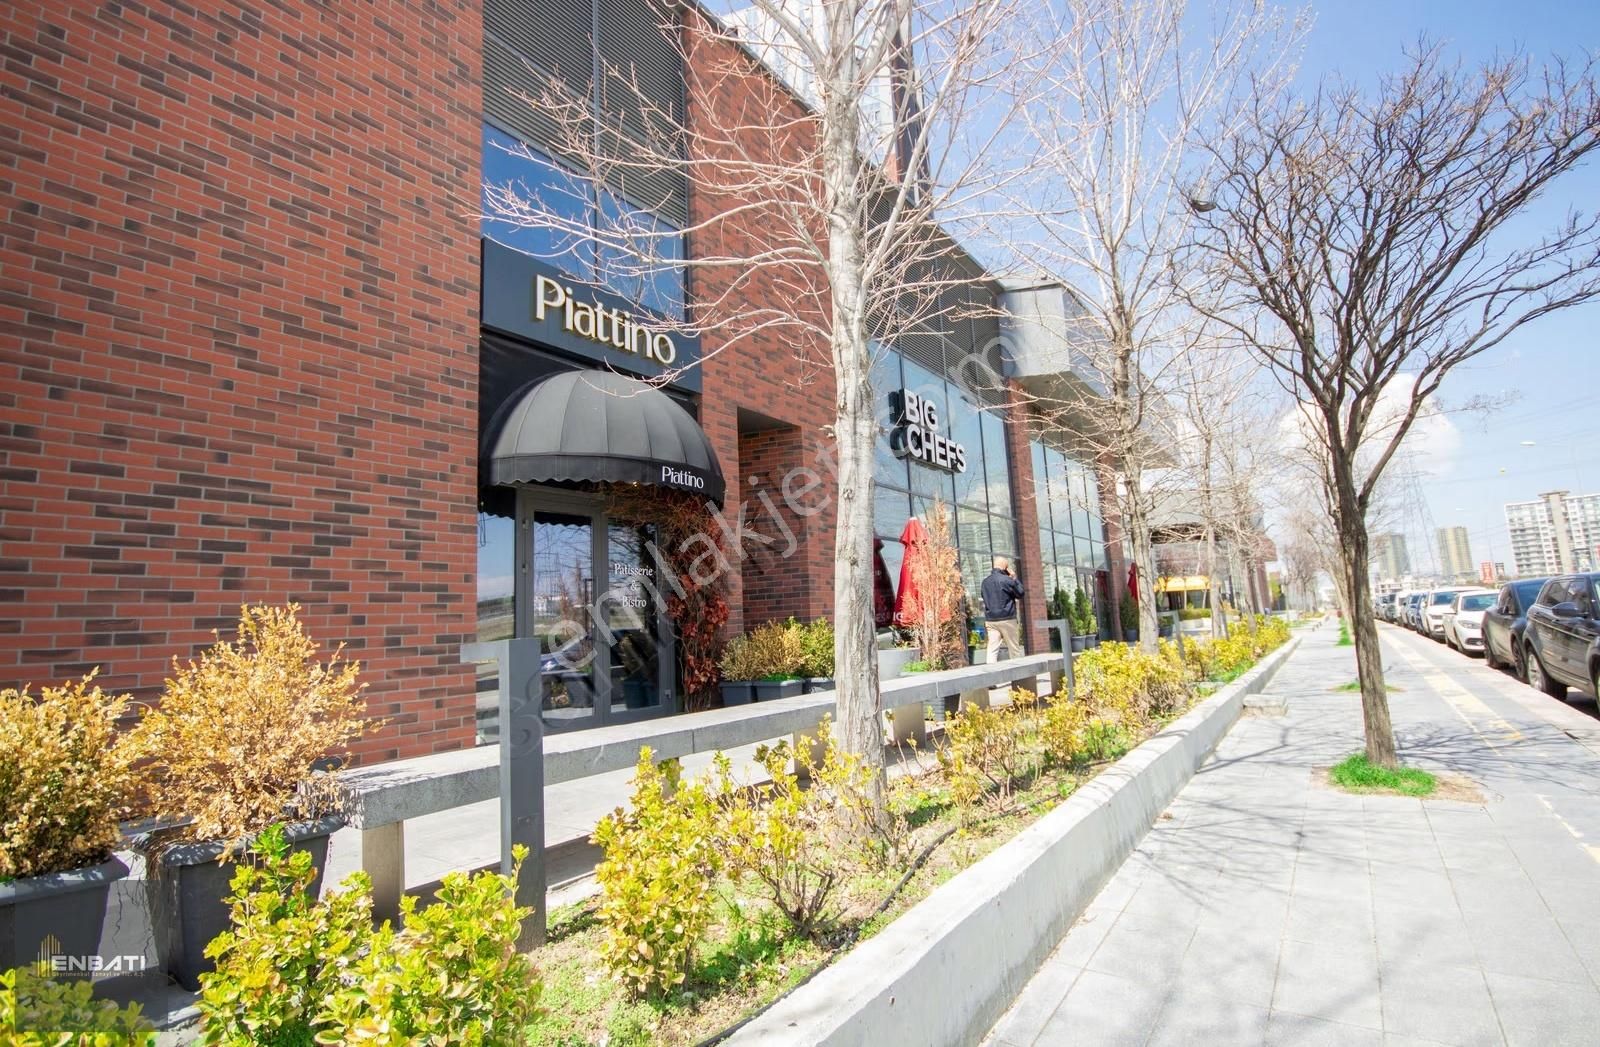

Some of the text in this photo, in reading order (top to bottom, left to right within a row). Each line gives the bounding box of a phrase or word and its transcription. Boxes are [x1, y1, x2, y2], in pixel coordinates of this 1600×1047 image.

[536, 274, 676, 364] Piattino
[904, 388, 939, 432] BIG
[906, 424, 967, 473] CHEFS
[662, 465, 704, 489] Piattino
[622, 596, 647, 608] Bistro
